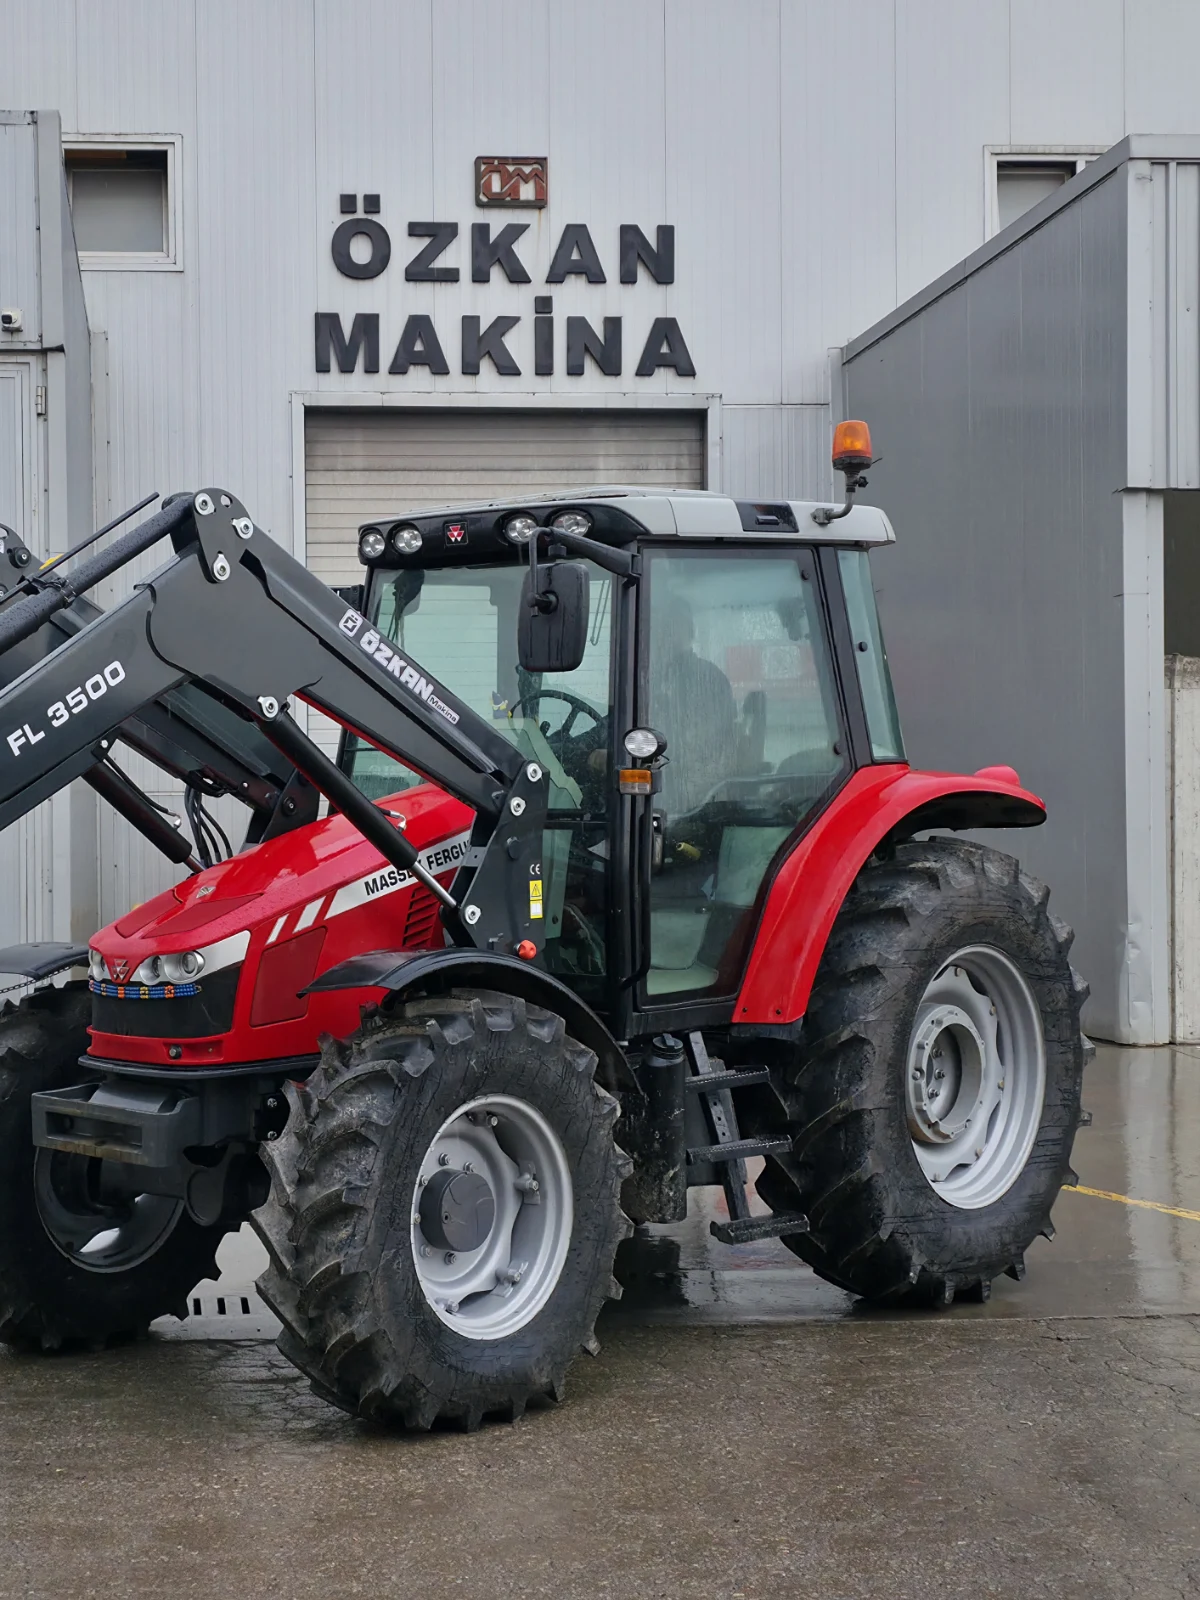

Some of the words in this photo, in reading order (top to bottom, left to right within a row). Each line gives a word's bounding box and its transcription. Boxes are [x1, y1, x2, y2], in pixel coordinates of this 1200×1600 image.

[331, 194, 675, 284] ÖZKAN
[314, 295, 697, 377] MAKİNA
[6, 723, 46, 757] FL
[47, 660, 126, 728] 3500
[360, 629, 434, 701] ÖZKAN
[429, 696, 458, 722] Makina
[364, 859, 421, 896] MASS
